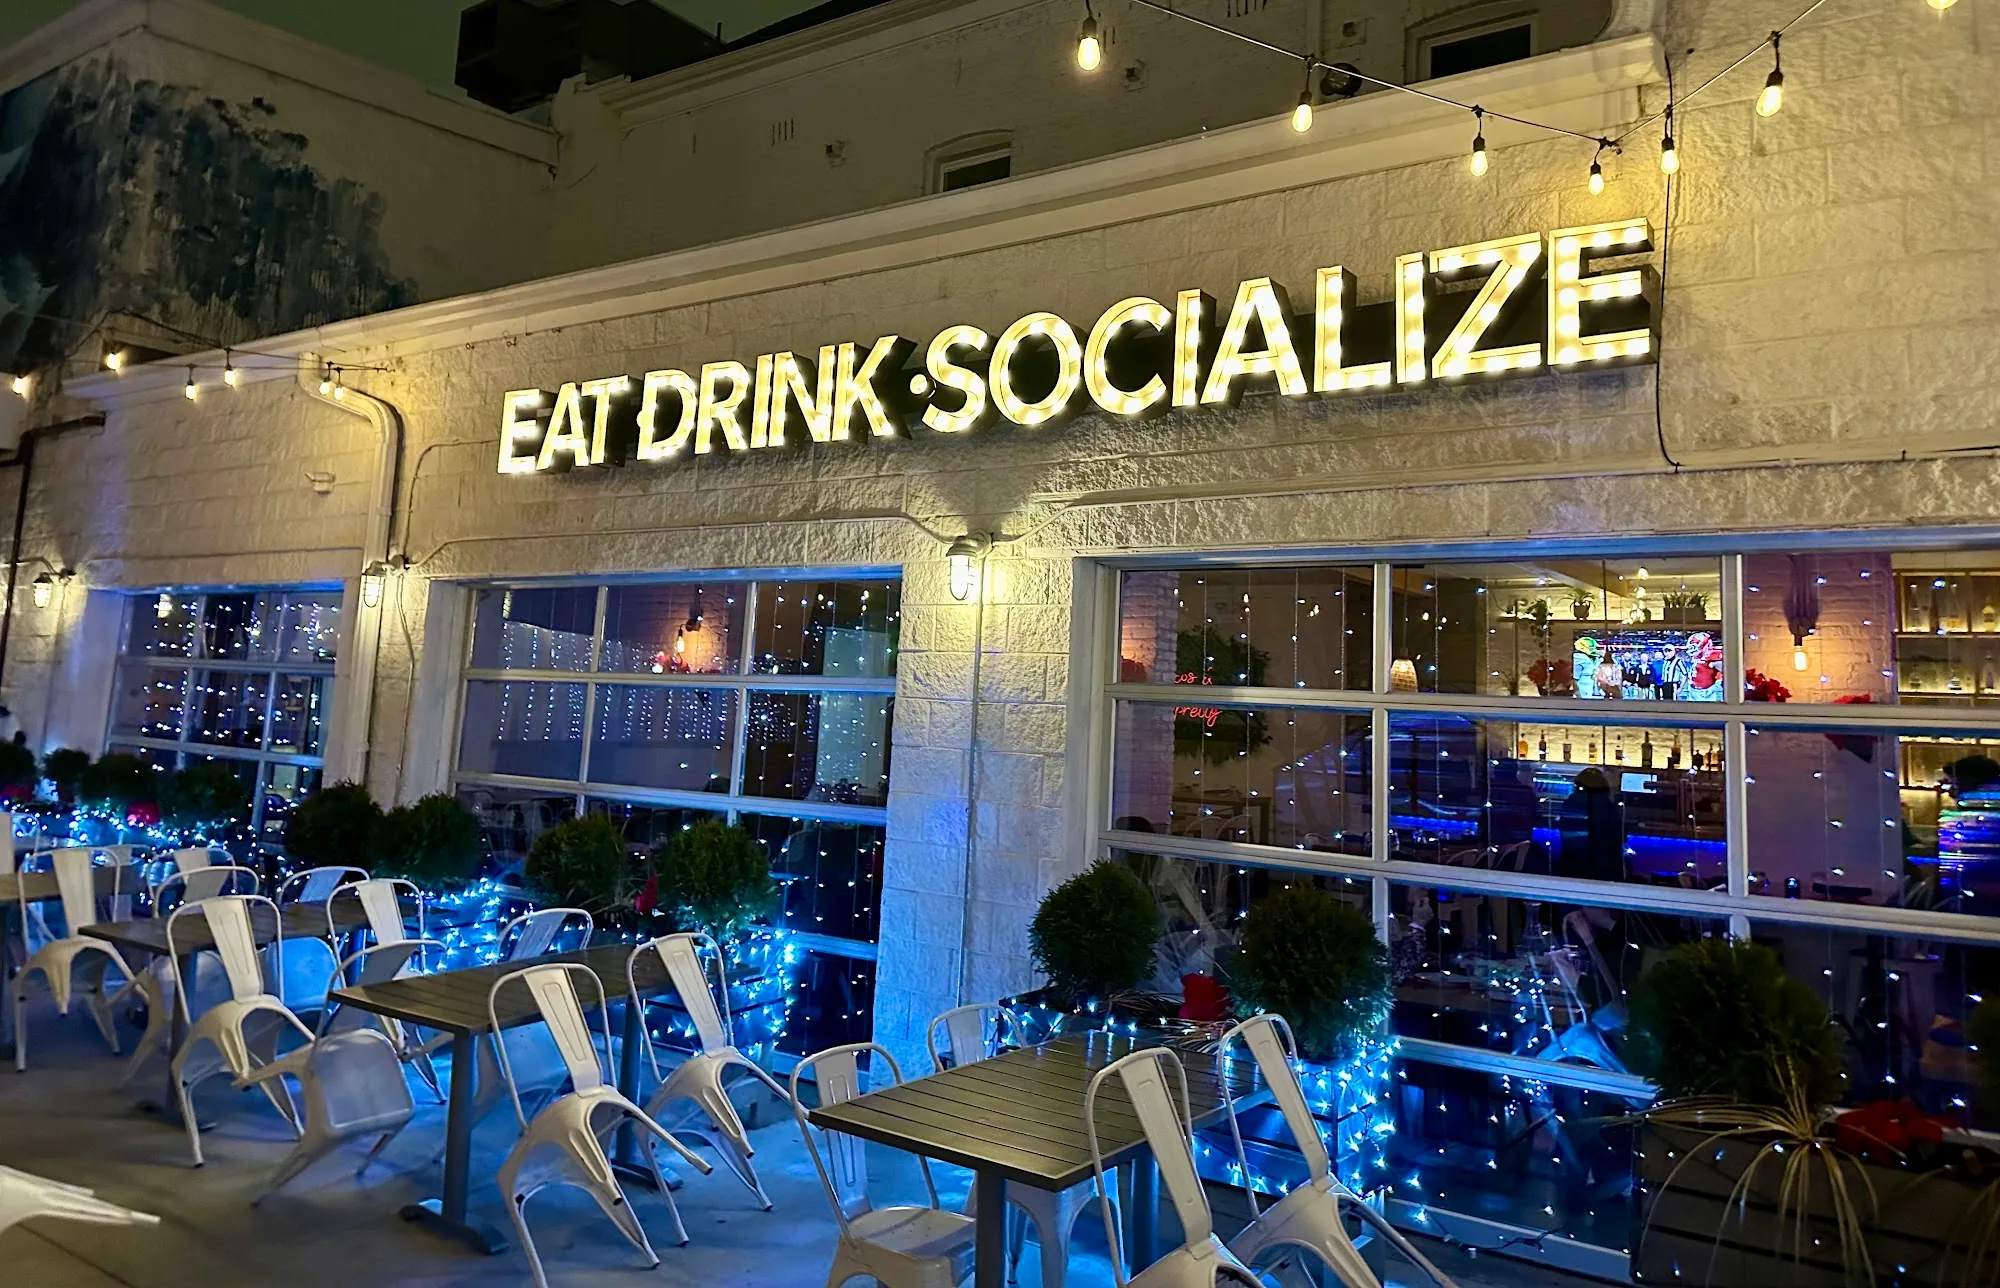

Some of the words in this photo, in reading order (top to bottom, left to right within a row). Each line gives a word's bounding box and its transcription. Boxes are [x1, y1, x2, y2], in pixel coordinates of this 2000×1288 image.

[498, 374, 630, 474] EAT
[638, 335, 898, 461] DRINK
[921, 218, 1651, 432] SOCIALIZE
